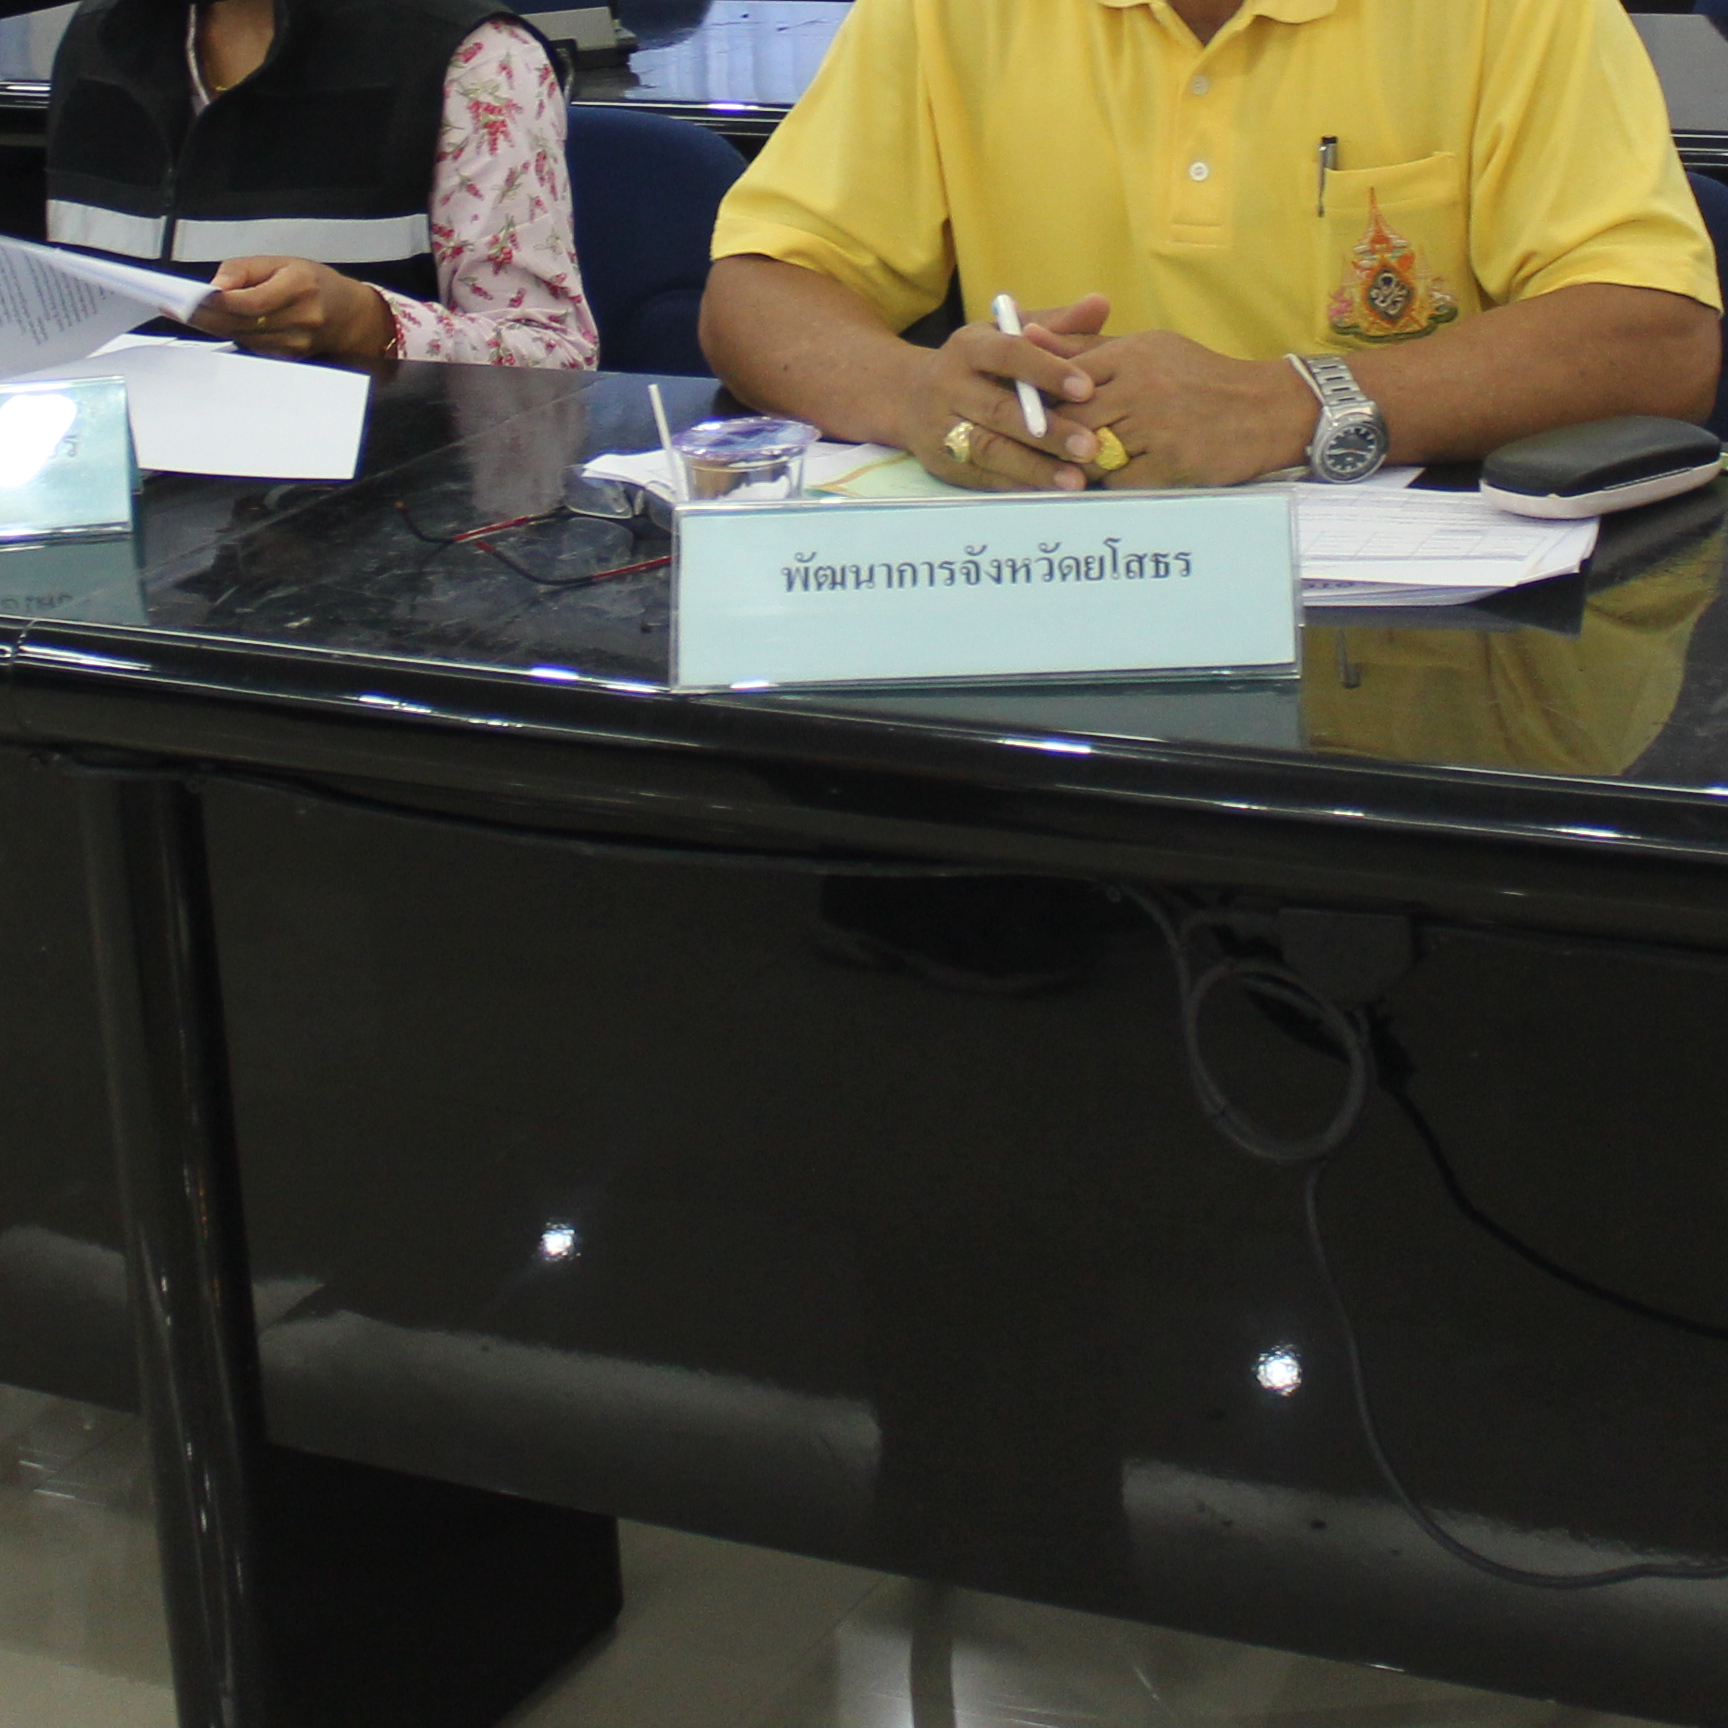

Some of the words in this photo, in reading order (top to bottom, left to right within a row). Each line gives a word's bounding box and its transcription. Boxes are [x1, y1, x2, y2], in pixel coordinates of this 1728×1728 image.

[780, 537, 1193, 593] พัฒนาการจังหวัดยโสธร
